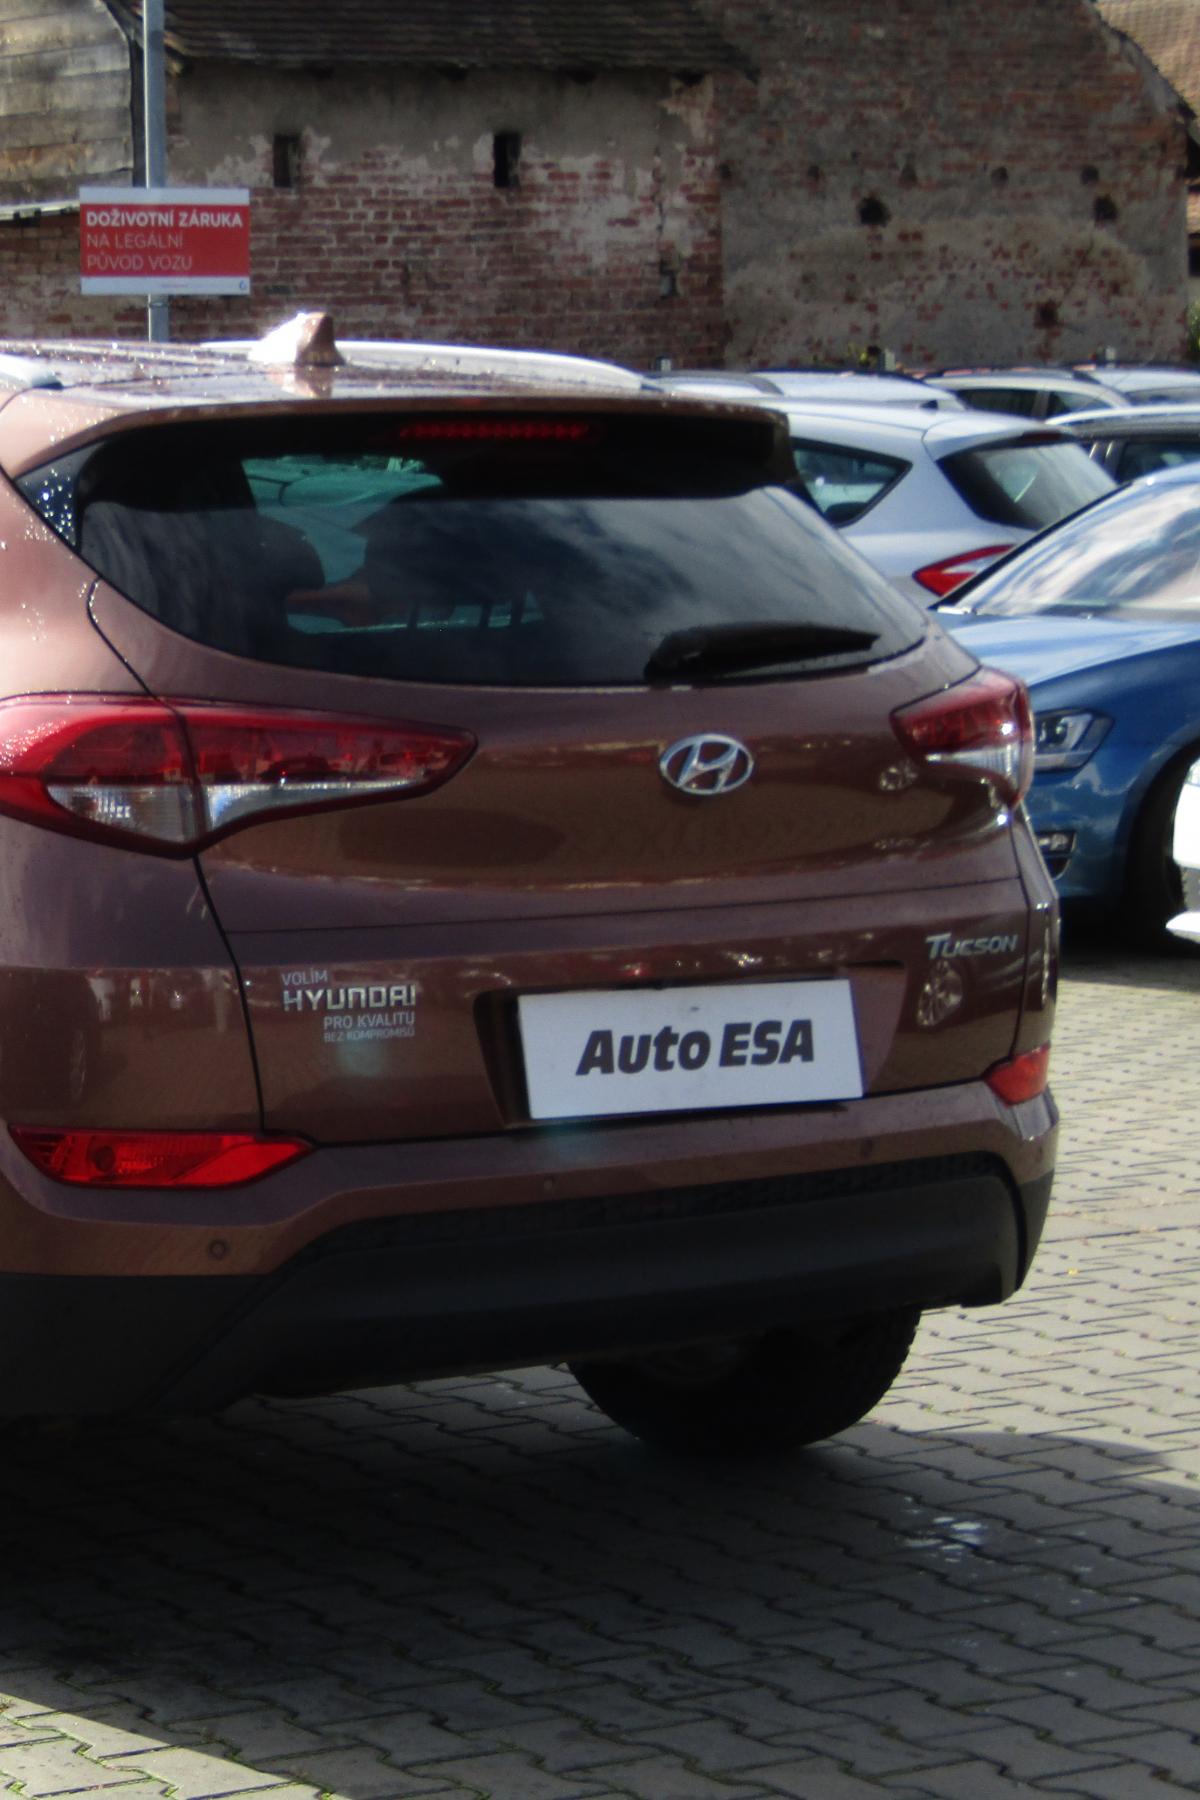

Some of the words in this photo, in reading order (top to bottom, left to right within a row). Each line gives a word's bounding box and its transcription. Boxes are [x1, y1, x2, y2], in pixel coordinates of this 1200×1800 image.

[86, 208, 174, 228] DOŽIVOTNÍ
[179, 208, 243, 228] ZÁRUKA
[87, 234, 110, 249] NA
[148, 255, 193, 270] VOZU
[283, 984, 416, 1012] HYUNDAI
[323, 1015, 352, 1030] PRO
[357, 1012, 415, 1028] KVALITU
[575, 1026, 711, 1076] Auto
[718, 1019, 814, 1068] ESA
